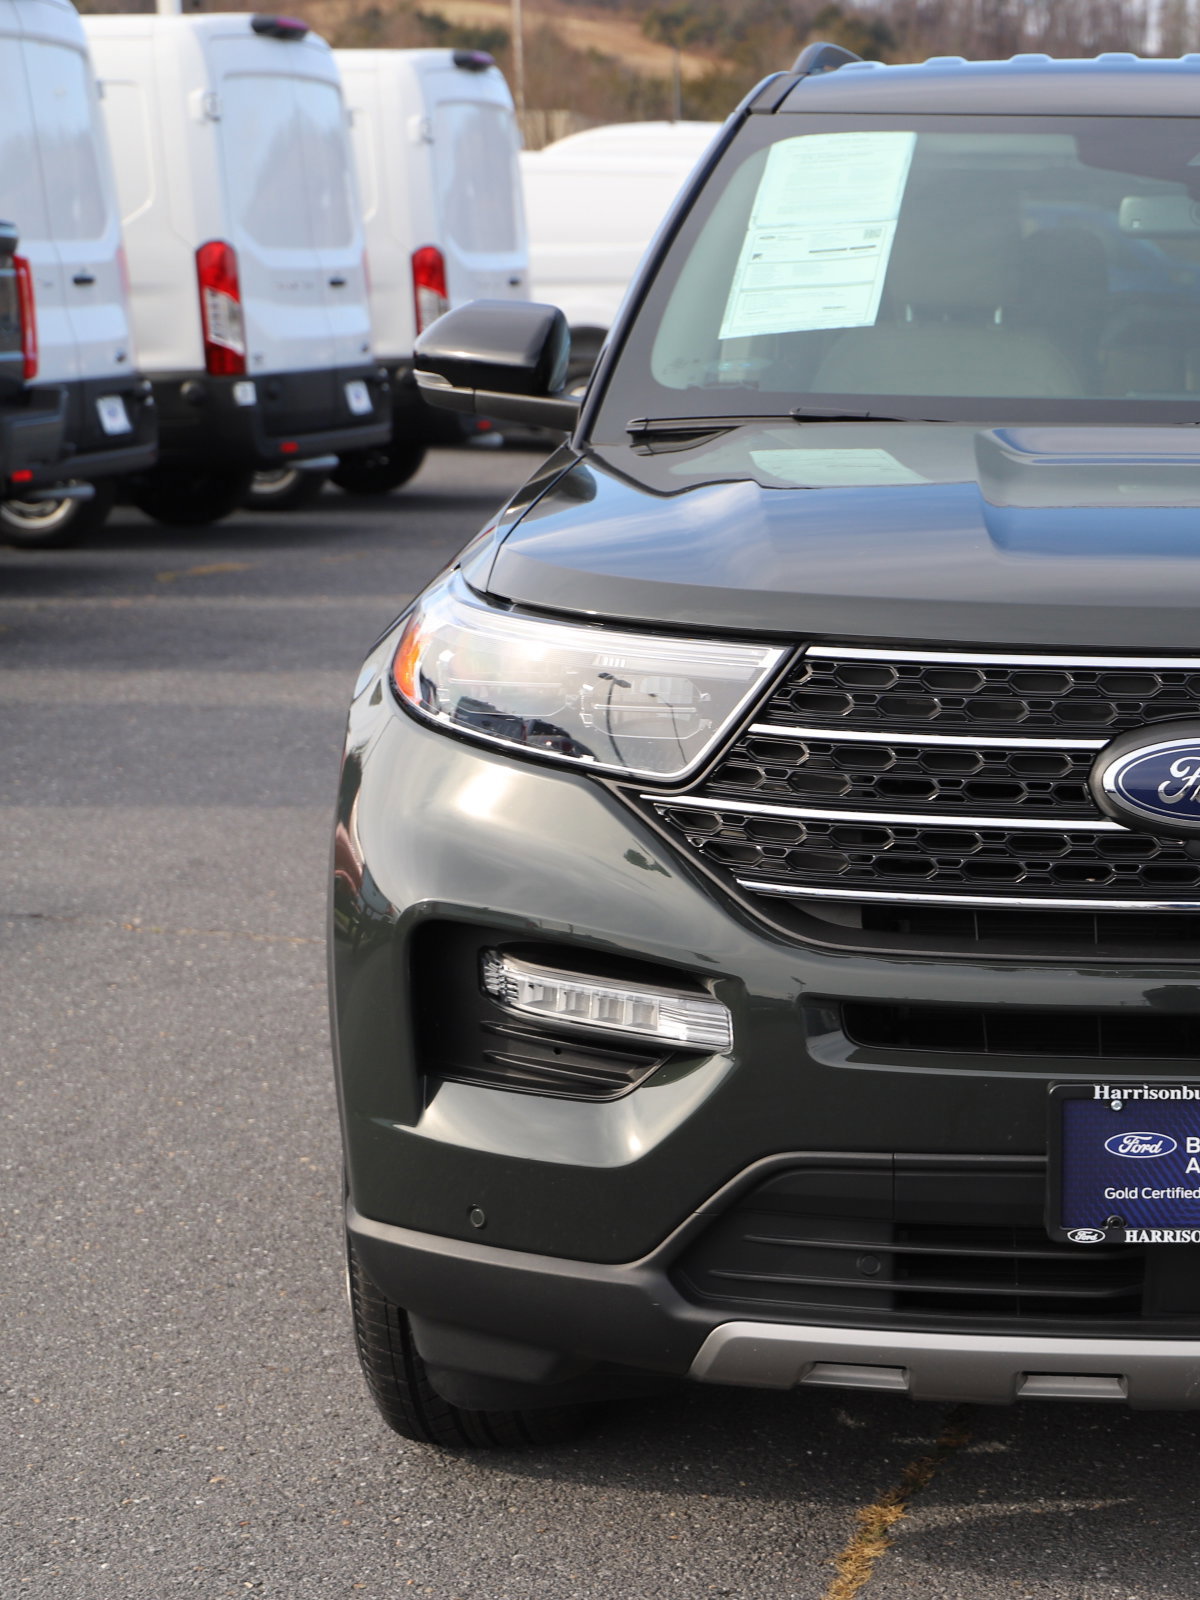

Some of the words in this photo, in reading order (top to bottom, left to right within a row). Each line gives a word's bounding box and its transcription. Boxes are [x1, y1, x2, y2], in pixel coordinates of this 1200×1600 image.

[1117, 1135, 1164, 1155] Ford
[1104, 1187, 1139, 1200] Gold
[1075, 1230, 1098, 1242] Ford
